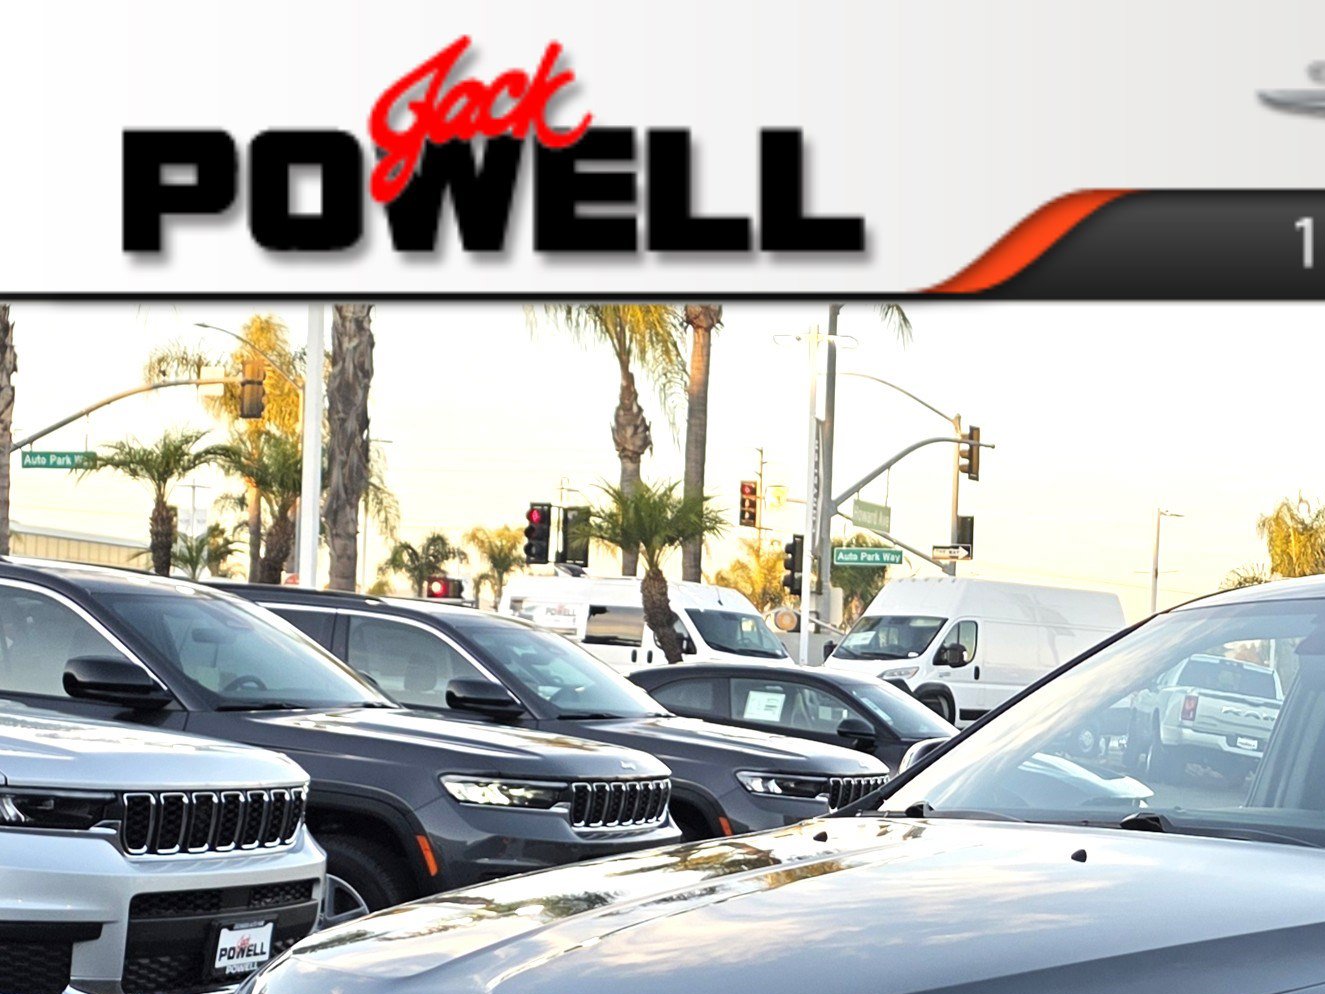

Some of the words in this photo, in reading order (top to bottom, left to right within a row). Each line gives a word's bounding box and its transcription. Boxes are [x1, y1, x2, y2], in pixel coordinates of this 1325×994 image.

[24, 454, 47, 465] Auto
[49, 454, 72, 465] Park
[837, 551, 858, 561] Auto
[860, 552, 880, 562] Park
[881, 552, 901, 563] Way
[218, 942, 267, 962] POWELL
